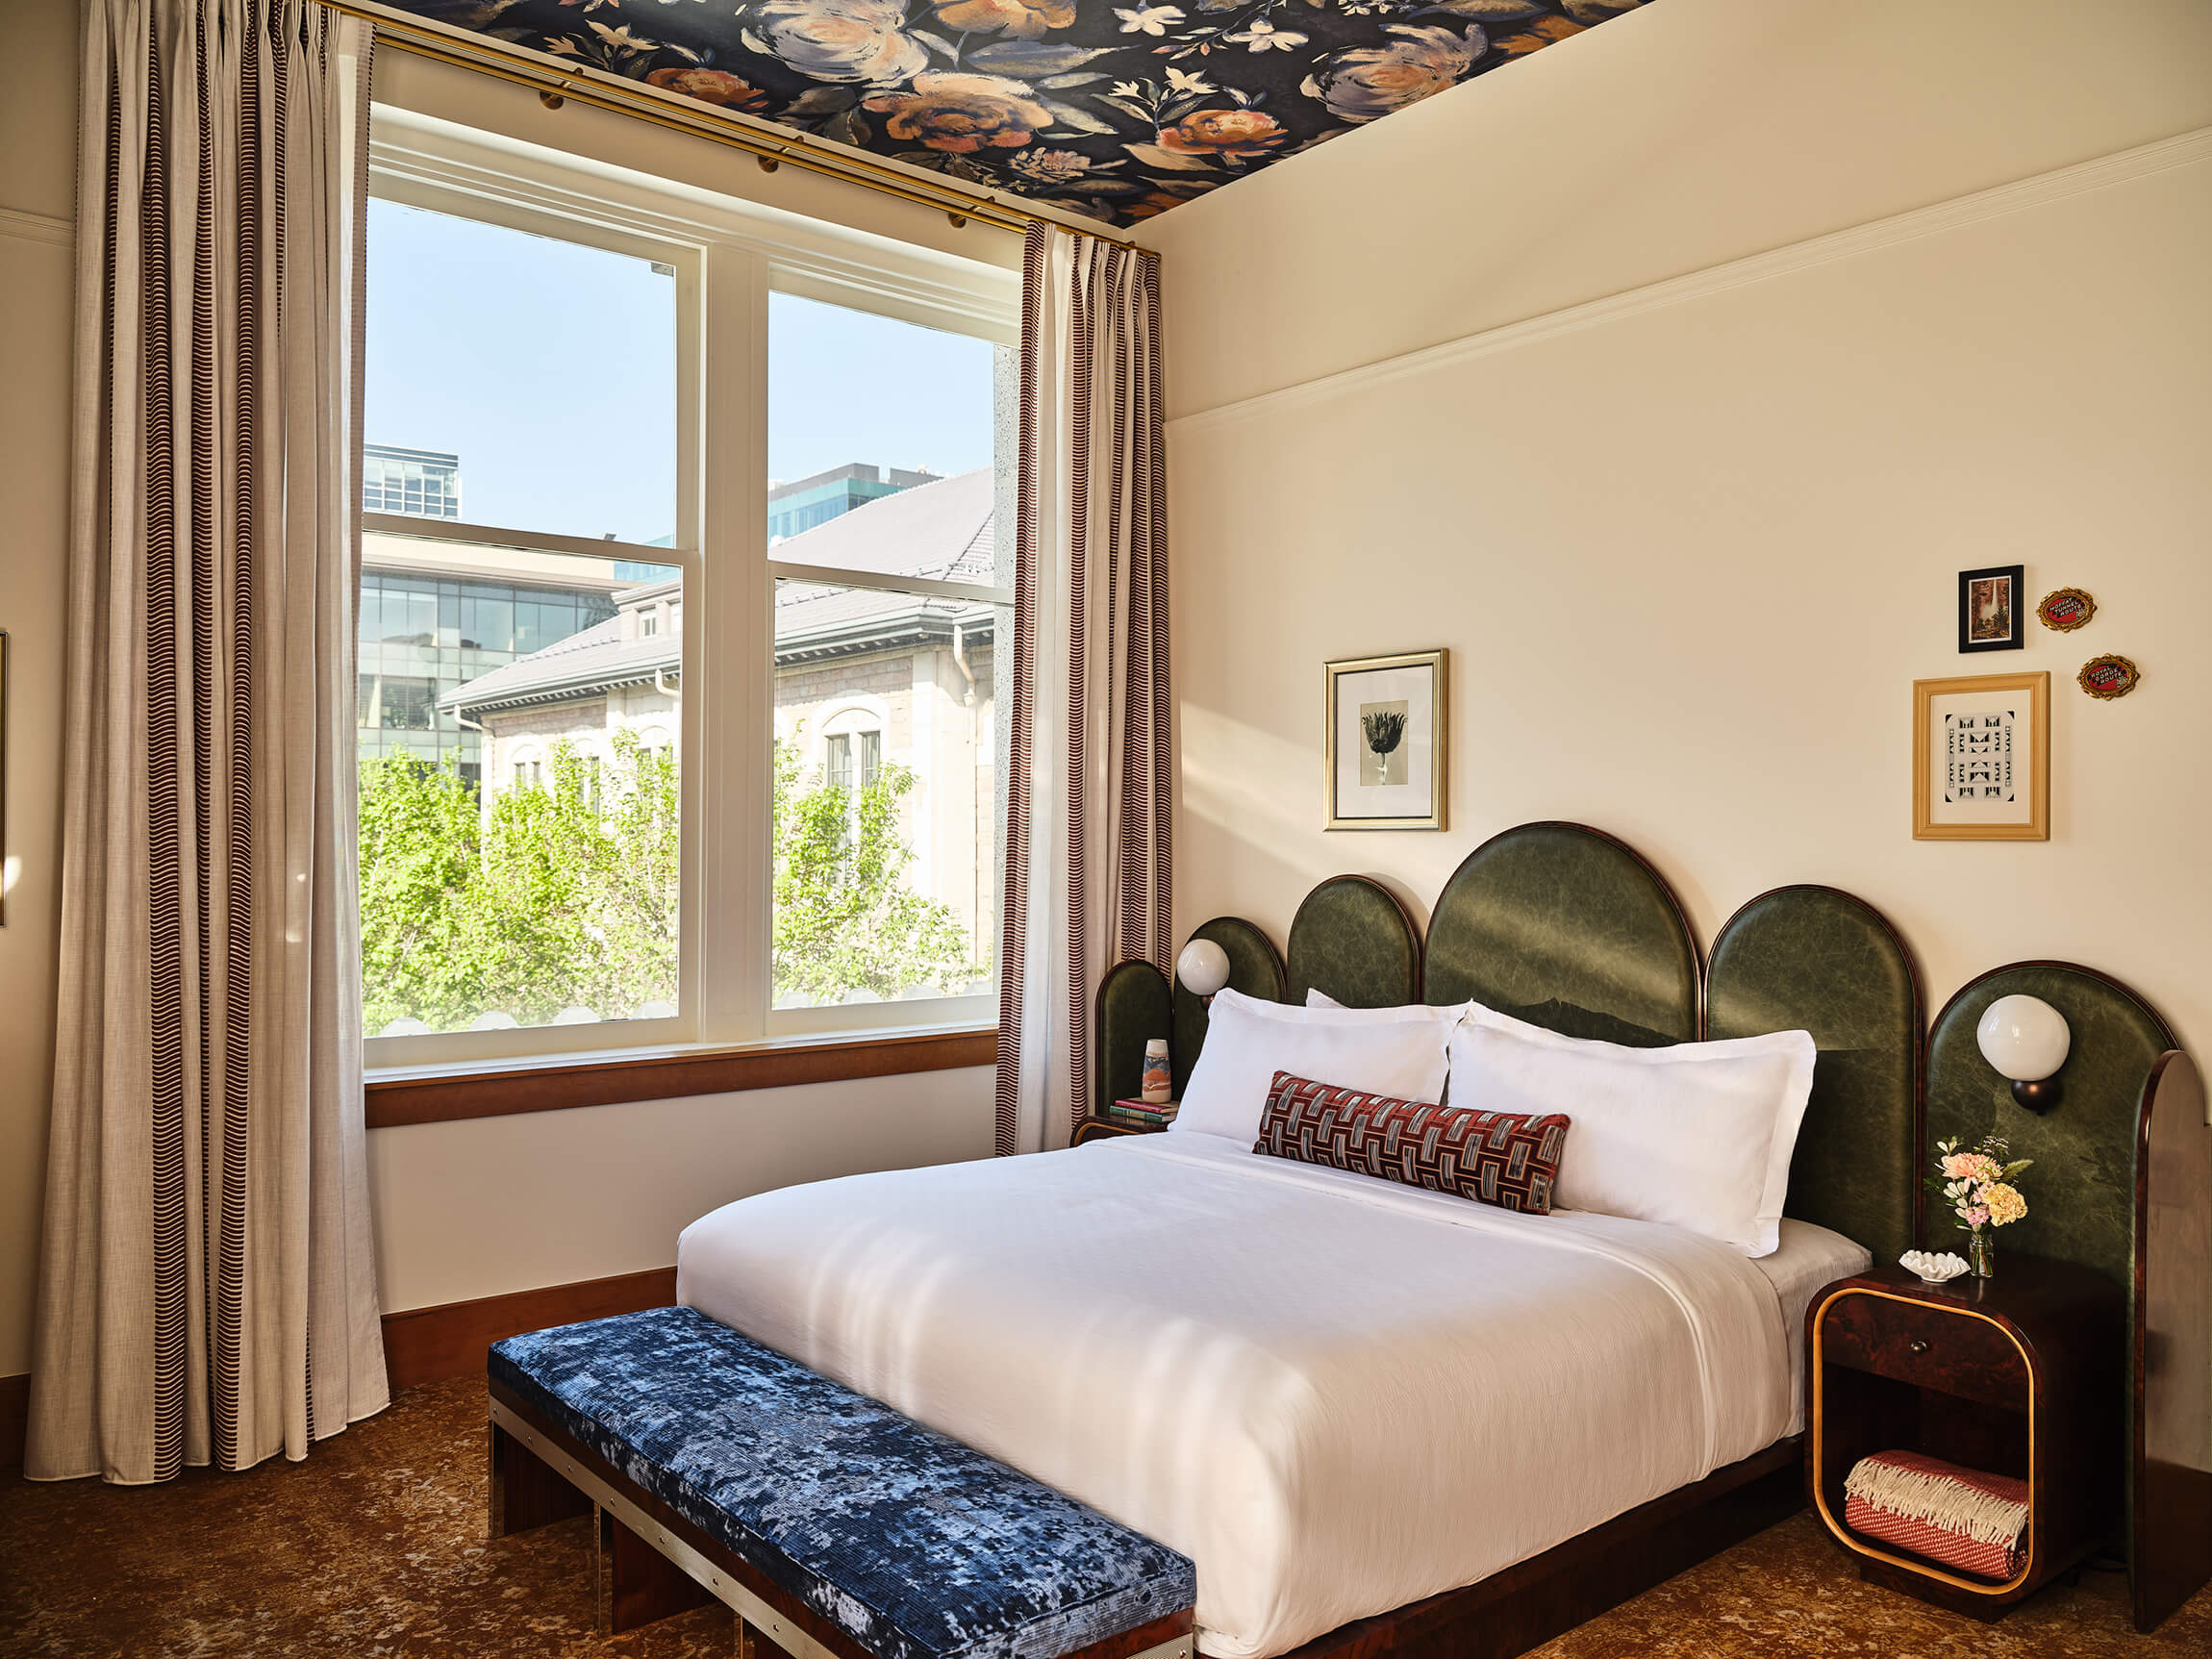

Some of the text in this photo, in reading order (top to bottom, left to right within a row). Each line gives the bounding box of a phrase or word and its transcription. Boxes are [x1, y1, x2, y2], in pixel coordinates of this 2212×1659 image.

[2049, 597, 2073, 611] MOFFAT
[2055, 600, 2079, 613] TUNNEL
[2060, 604, 2081, 616] ROUTE
[2091, 666, 2111, 677] ROYAL
[2095, 668, 2119, 681] GORGE
[2100, 671, 2122, 684] ROUTE
